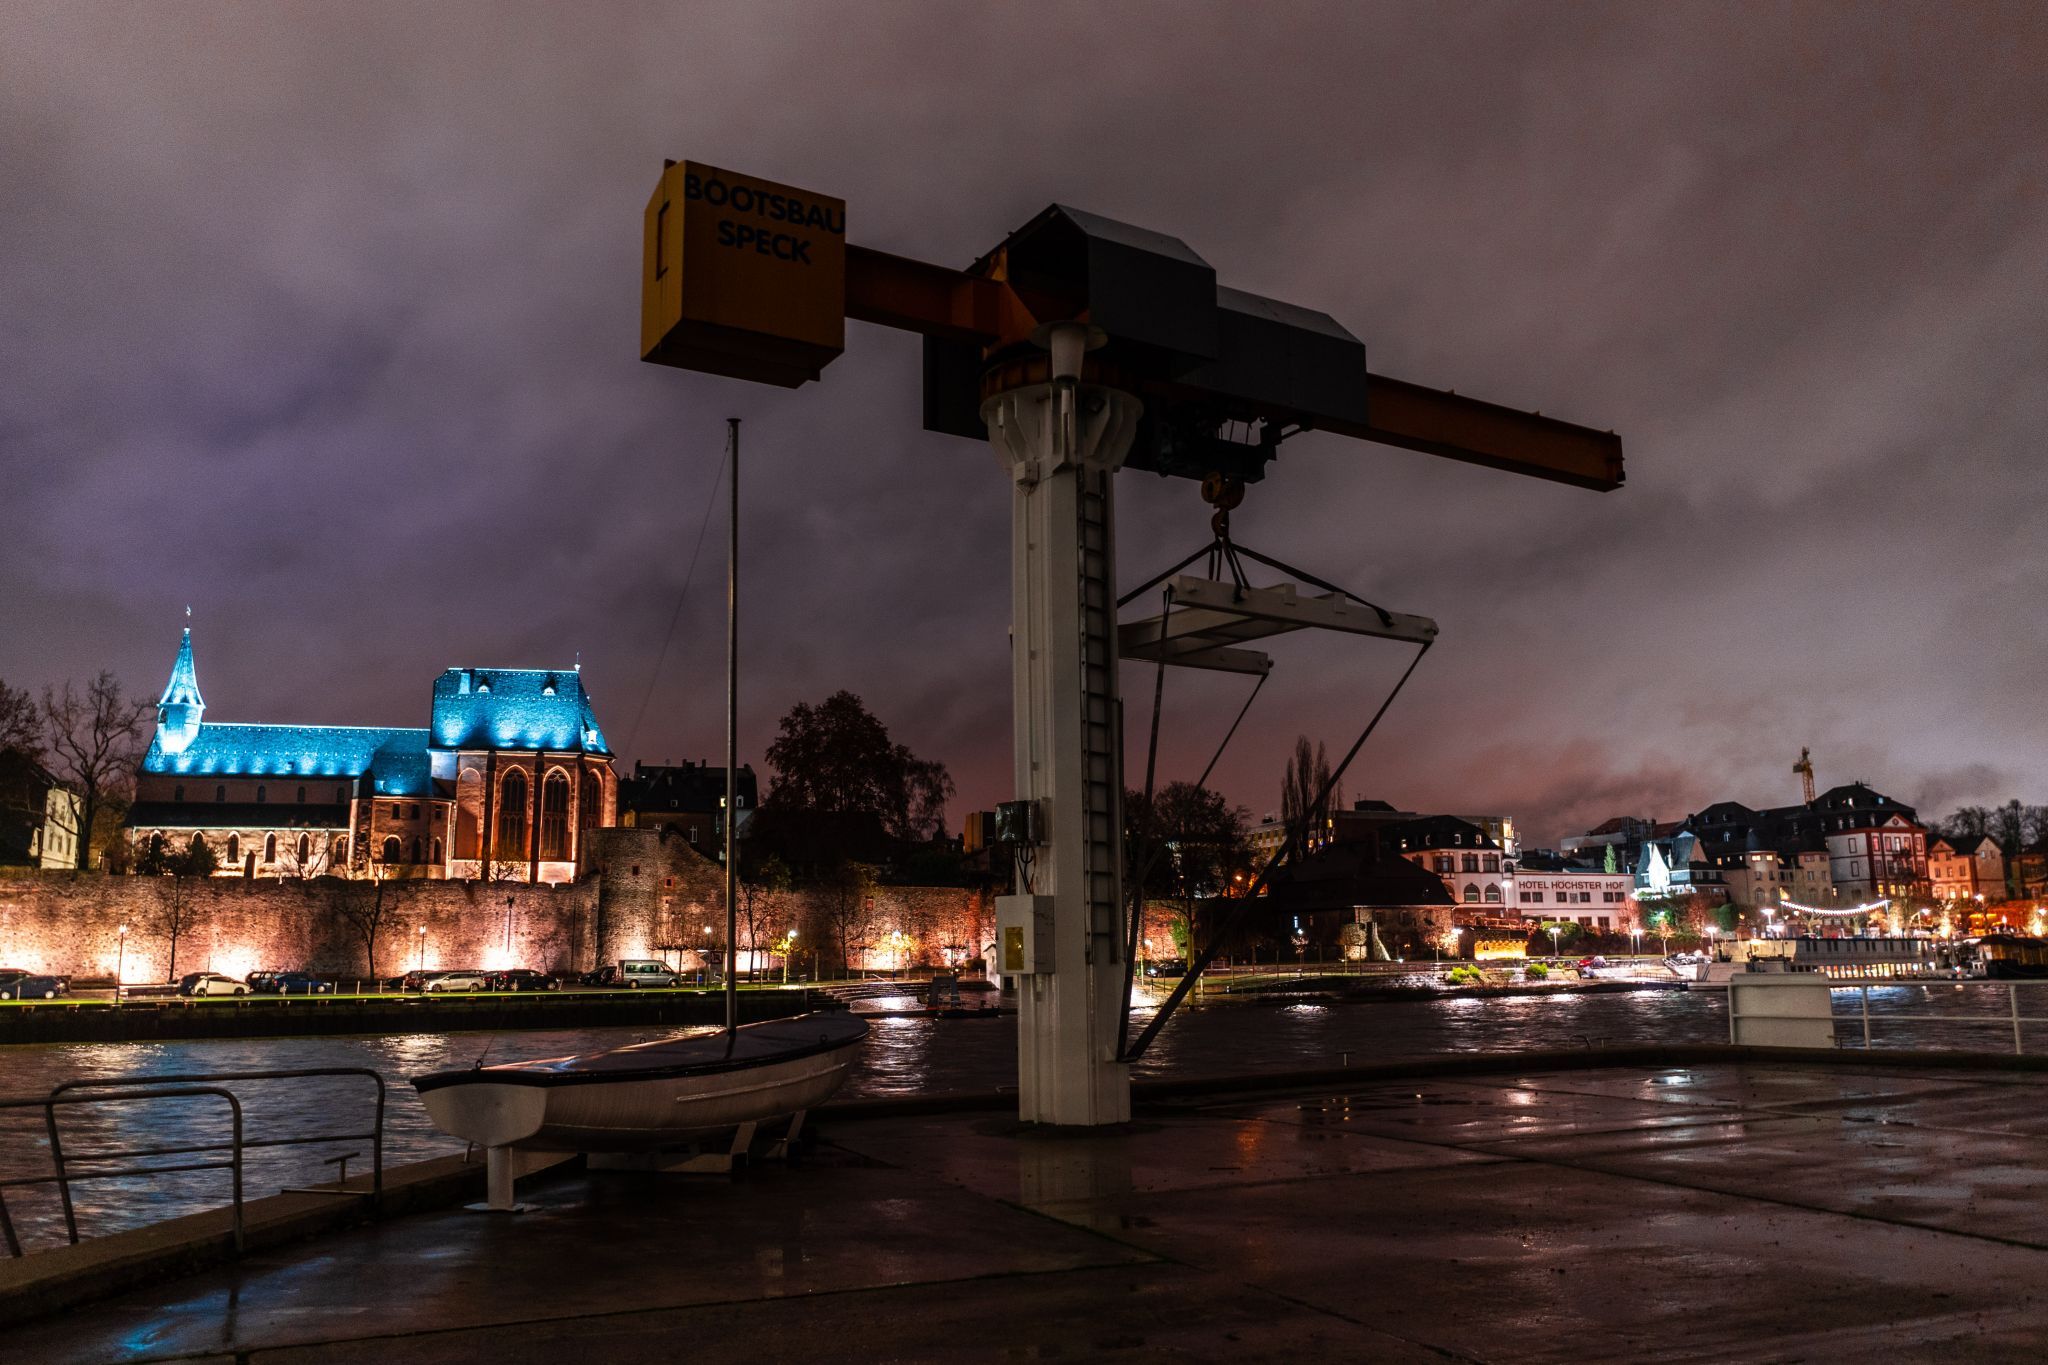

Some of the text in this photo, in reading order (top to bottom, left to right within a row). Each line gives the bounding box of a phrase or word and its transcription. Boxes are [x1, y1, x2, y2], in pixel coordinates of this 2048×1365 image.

[686, 174, 845, 233] BOOTSBAU
[718, 220, 811, 264] SPECK
[1518, 880, 1625, 889] HOTEL HÖCHSTER HOF
